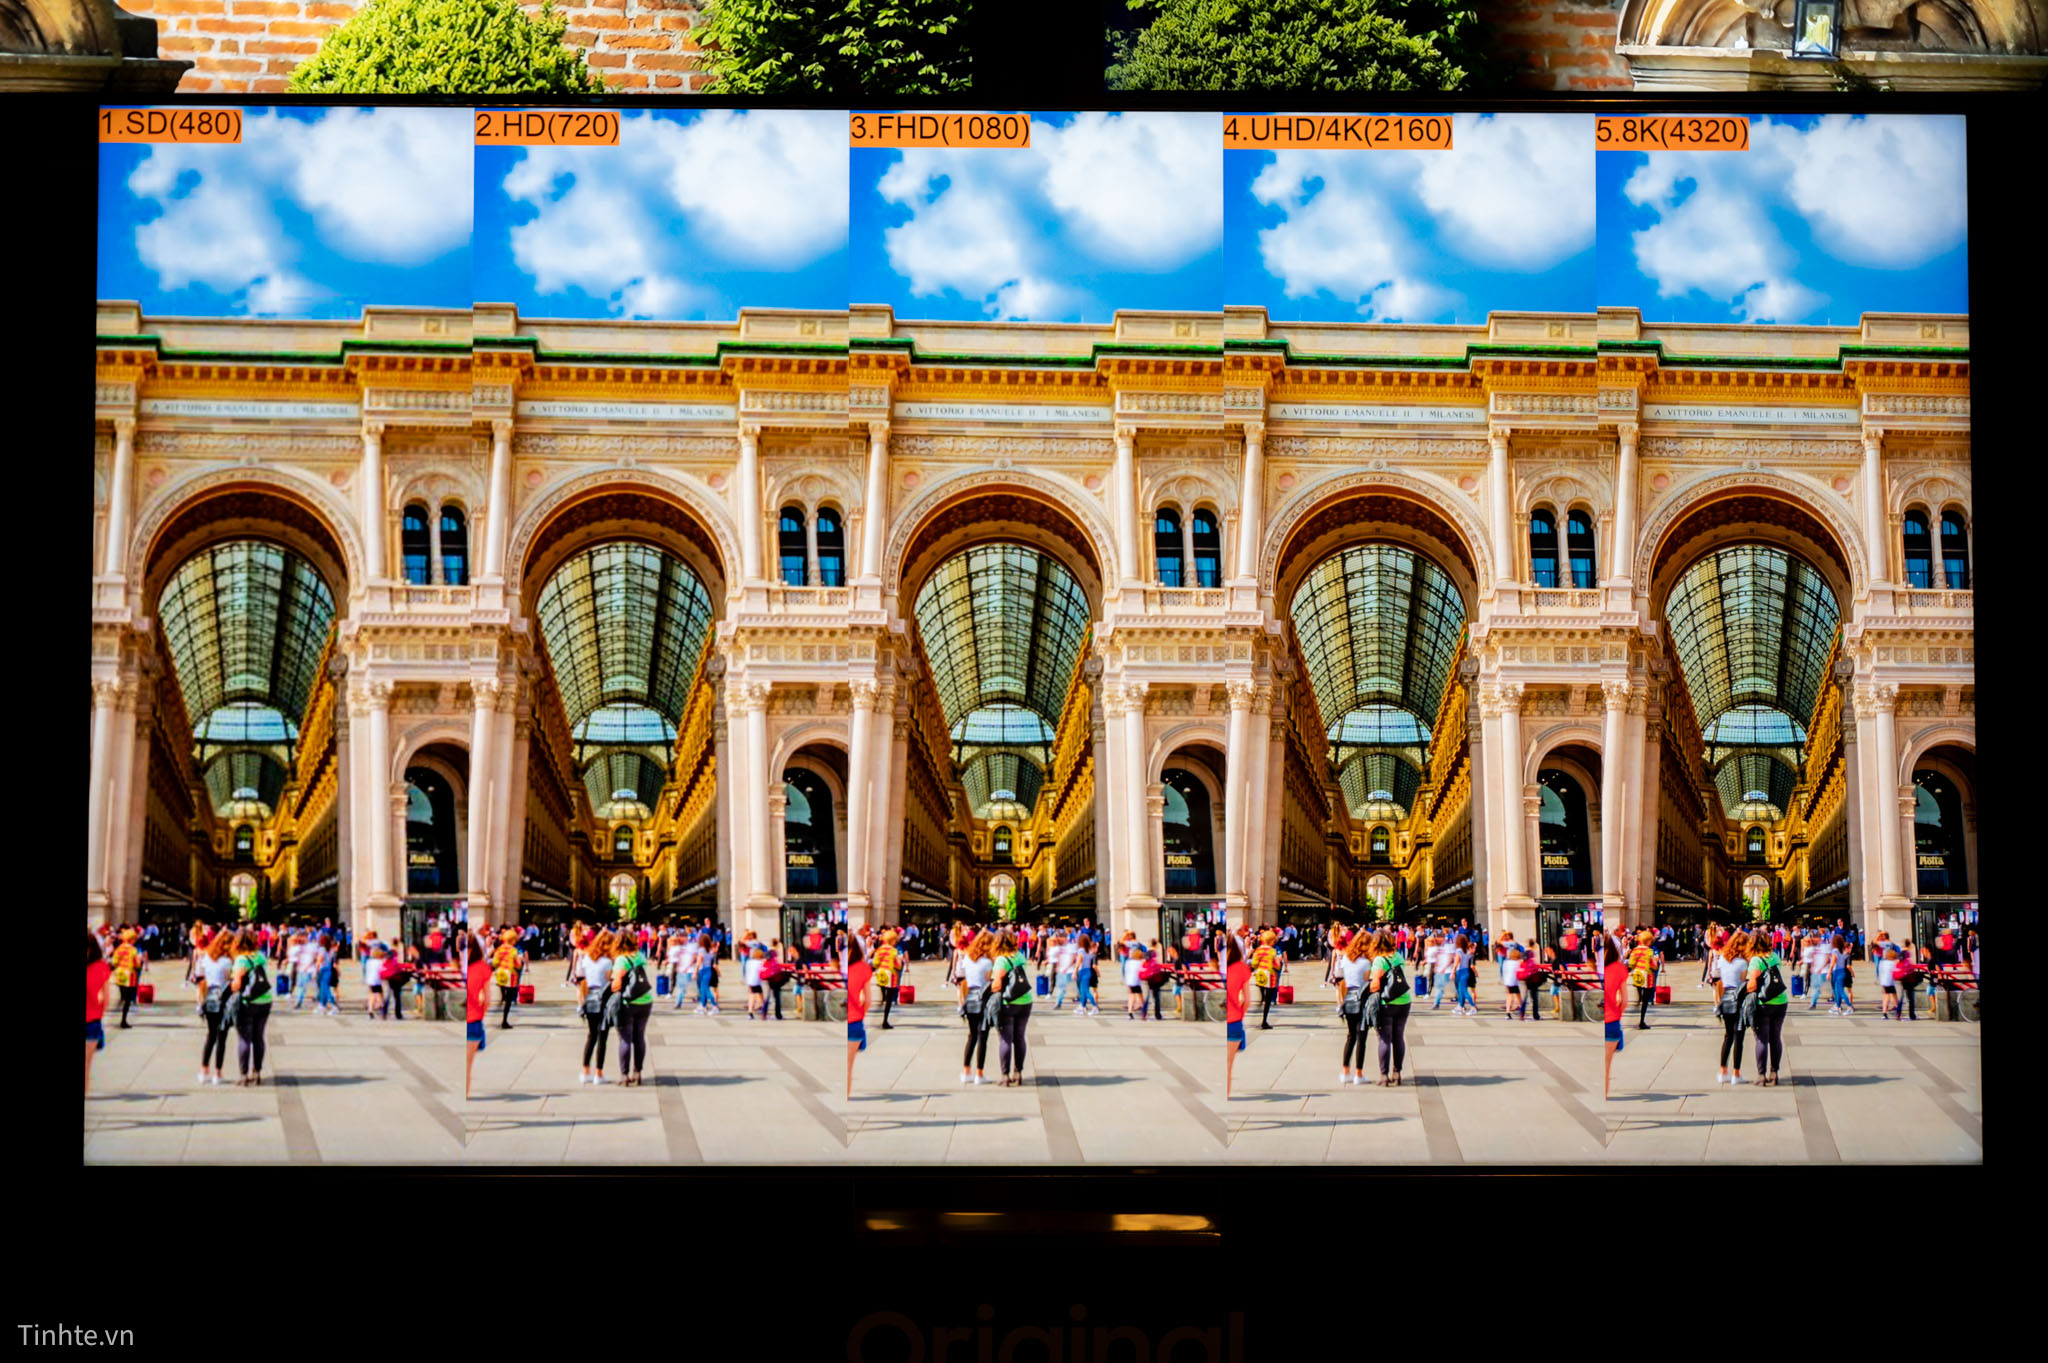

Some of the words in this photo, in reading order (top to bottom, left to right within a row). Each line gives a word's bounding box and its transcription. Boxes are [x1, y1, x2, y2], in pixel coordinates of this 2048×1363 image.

[102, 111, 241, 141] 1.SD(480)
[477, 113, 619, 143] 2.HD(720)
[851, 115, 1030, 146] 3.FHD(1080)
[1224, 117, 1452, 147] 4.UHD/4K(2160)
[1597, 119, 1749, 149] 5.8K(4320)
[1293, 408, 1339, 416] VITTORIO
[1345, 409, 1397, 417] EMANUELE
[1429, 410, 1474, 418] MILANESI
[1668, 409, 1712, 417] VITTORIO
[1718, 409, 1771, 418] EMANUELE
[1802, 411, 1847, 419] MILANESI
[1543, 855, 1569, 865] Motta
[1919, 855, 1944, 865] Motta
